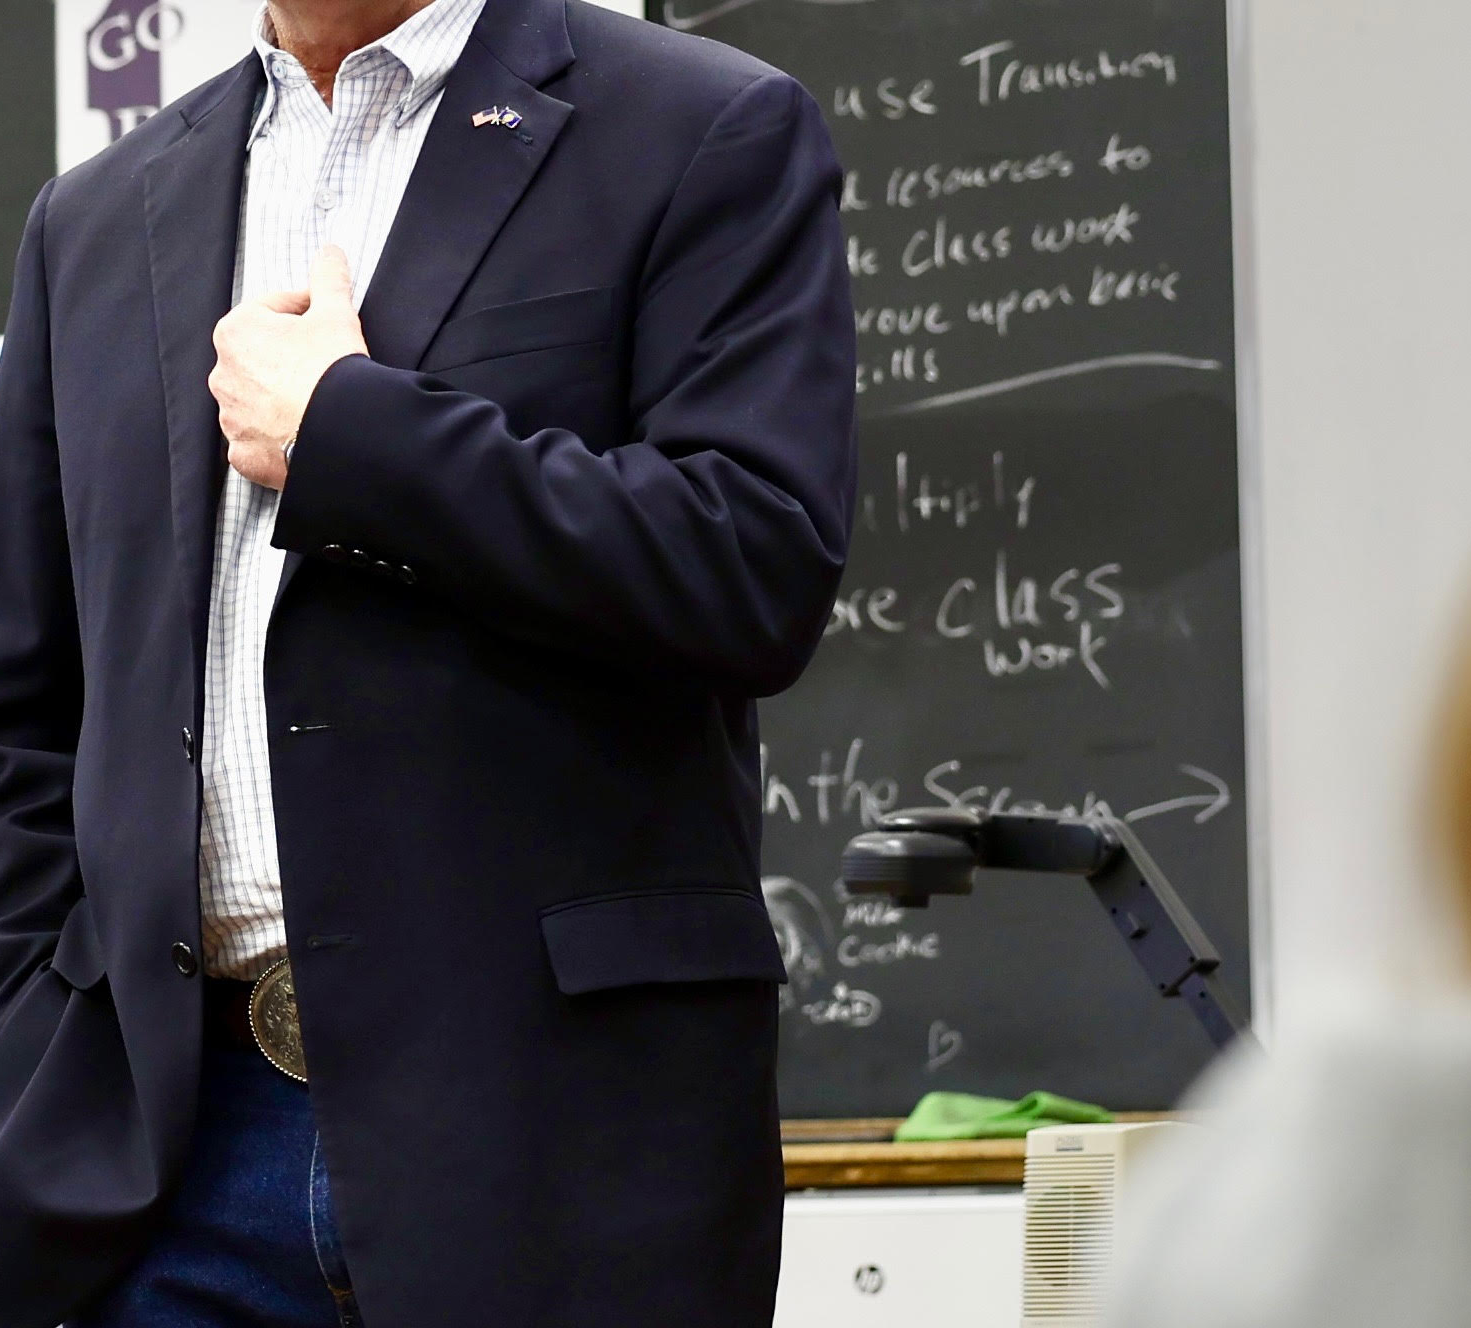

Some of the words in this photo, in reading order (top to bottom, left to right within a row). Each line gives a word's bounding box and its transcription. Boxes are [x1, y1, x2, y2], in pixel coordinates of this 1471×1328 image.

[88, 1, 184, 71] GO
[834, 78, 937, 119] use
[959, 39, 1177, 106] Transition
[1098, 132, 1151, 174] to
[1031, 202, 1140, 253] work
[968, 285, 1073, 336] upon
[1088, 265, 1180, 306] basic
[984, 620, 1110, 690] work
[808, 737, 899, 827] the
